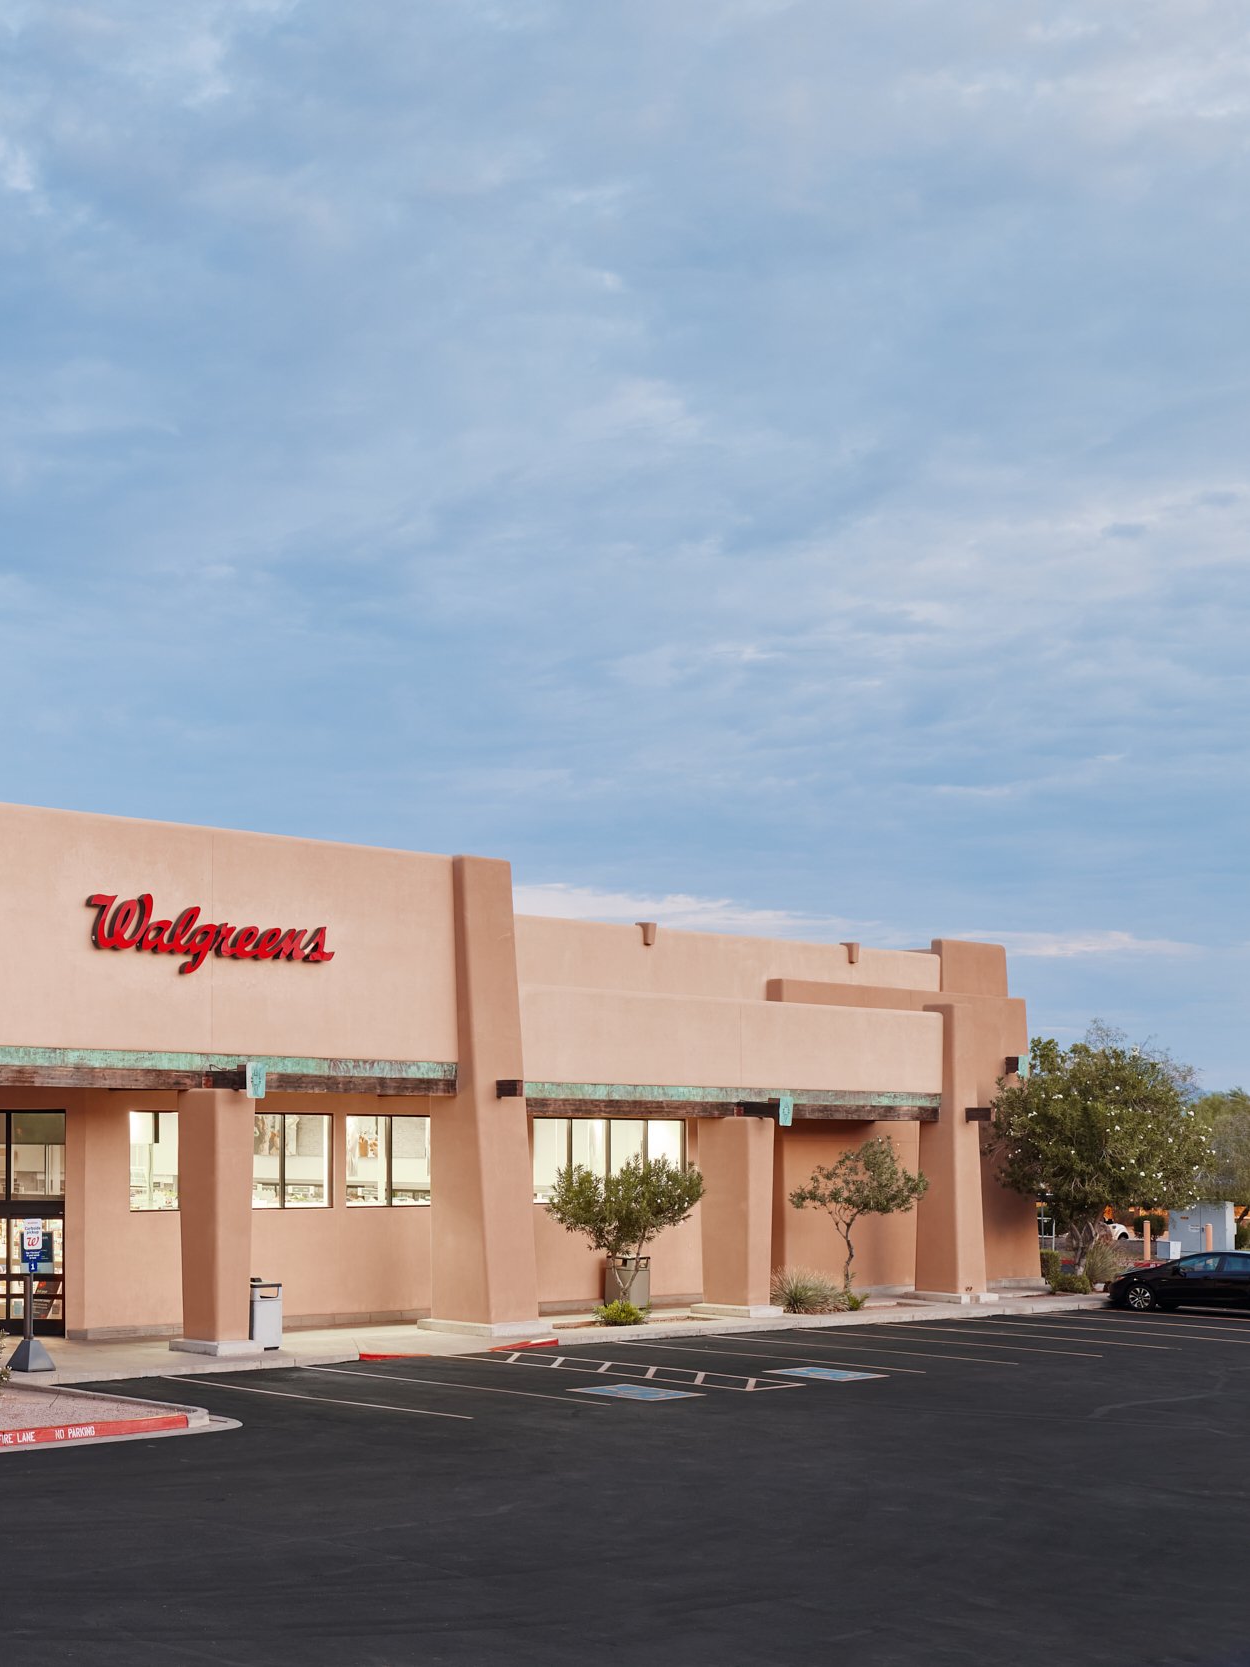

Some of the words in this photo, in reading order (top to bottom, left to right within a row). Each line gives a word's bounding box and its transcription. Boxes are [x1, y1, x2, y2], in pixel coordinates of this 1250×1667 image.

[86, 893, 335, 975] Walgreens
[31, 1263, 36, 1271] 1
[16, 1431, 36, 1443] LANE
[54, 1428, 65, 1440] NO
[67, 1425, 96, 1439] PARKING
